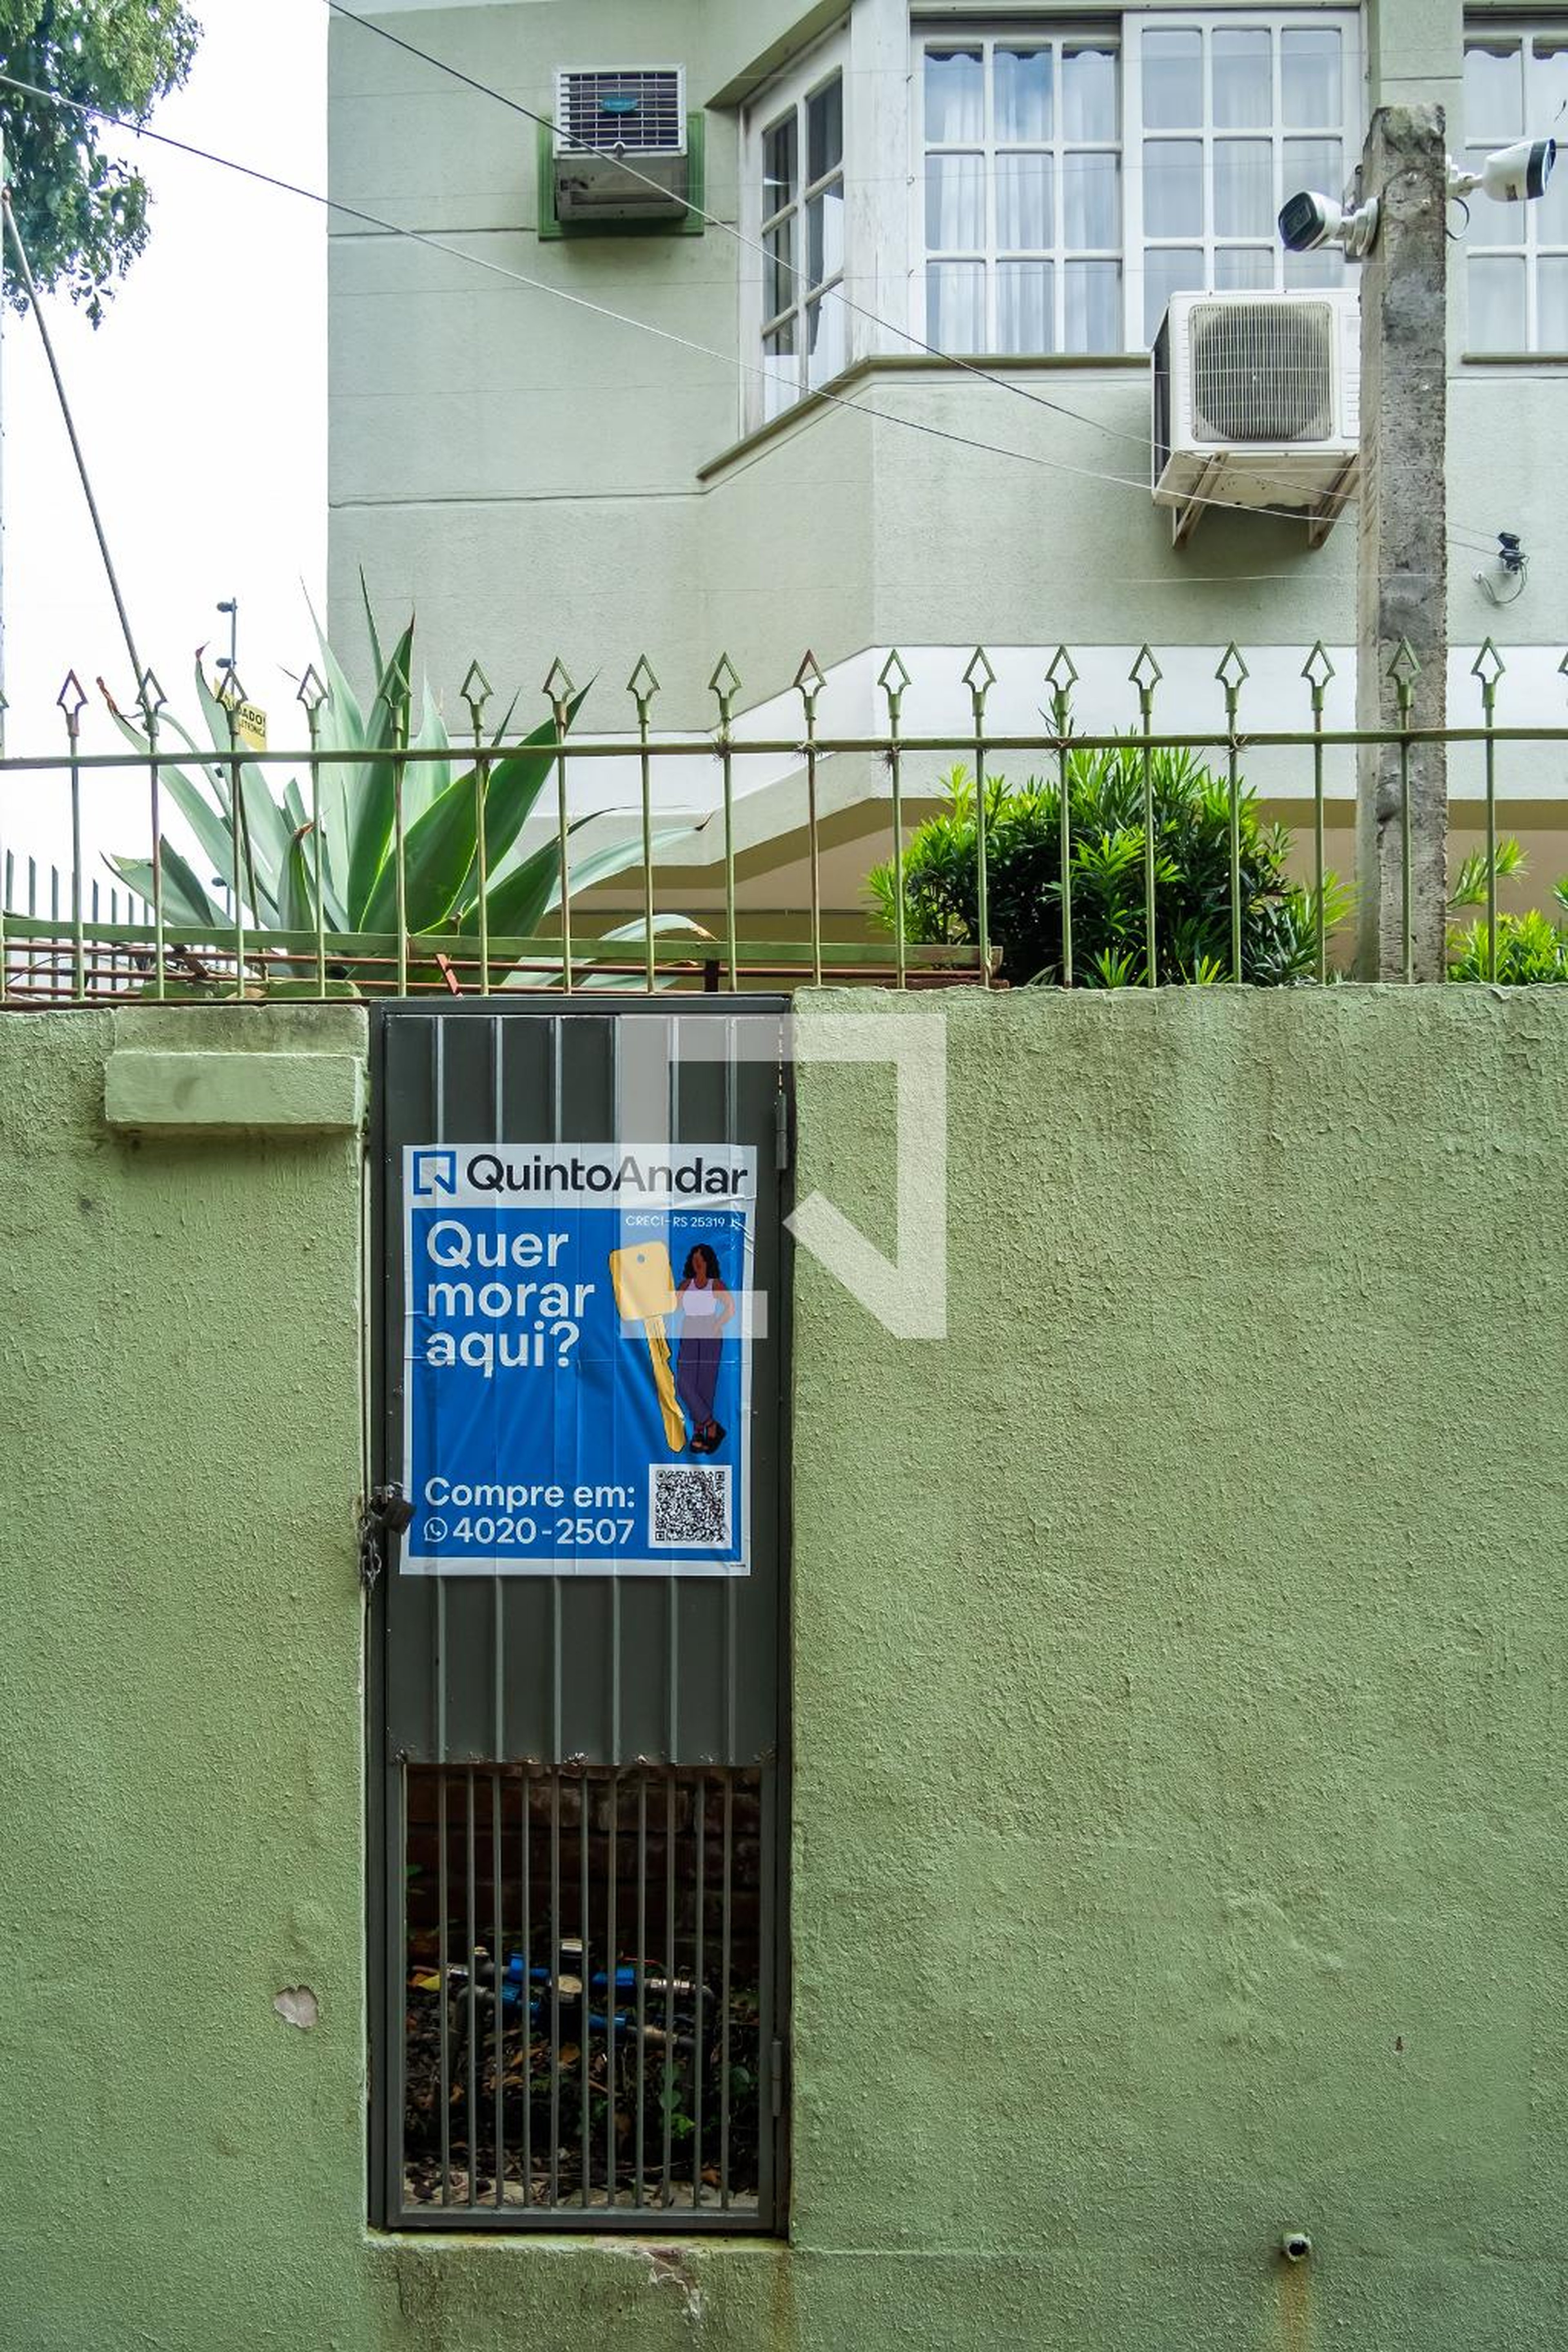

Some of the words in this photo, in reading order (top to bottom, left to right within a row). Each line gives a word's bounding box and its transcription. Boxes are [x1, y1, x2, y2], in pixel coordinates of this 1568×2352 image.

[467, 1154, 748, 1194] QuintoAndar
[690, 1216, 725, 1227] 25319
[427, 1220, 569, 1269] Quer
[428, 1283, 595, 1318] morar
[426, 1321, 579, 1377] aqui?
[425, 1477, 564, 1513] Compre
[573, 1485, 635, 1508] em:
